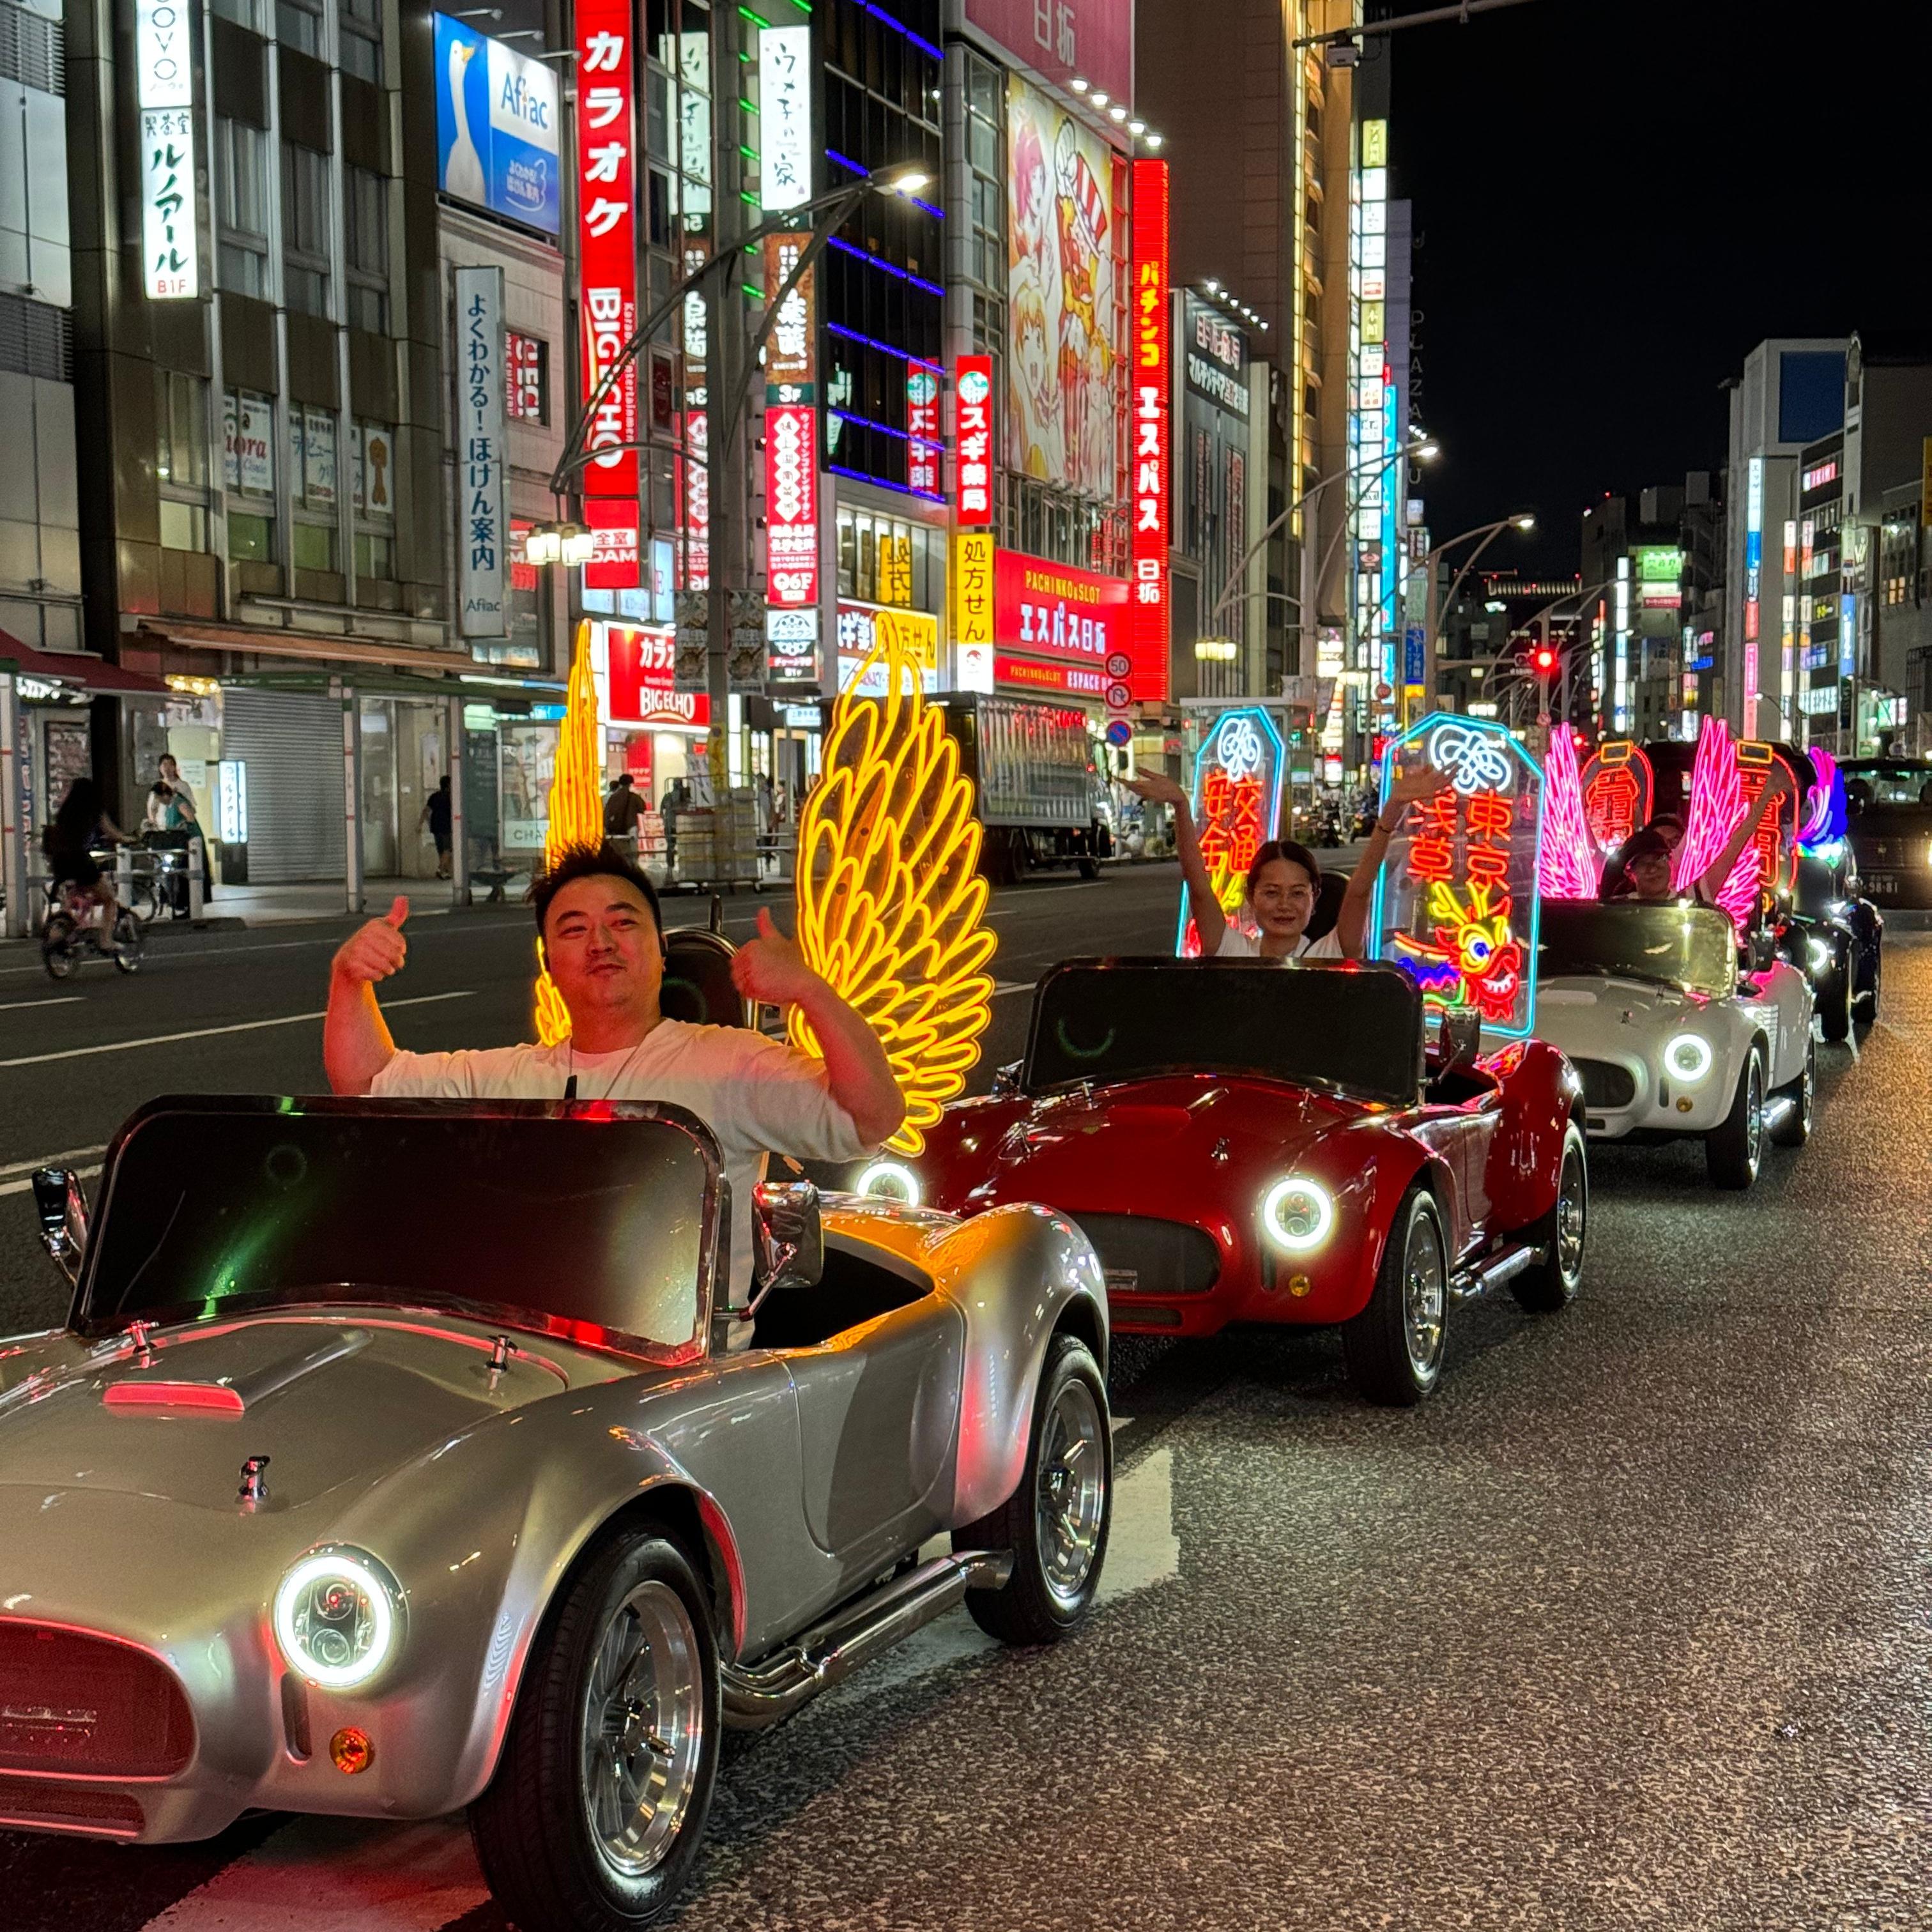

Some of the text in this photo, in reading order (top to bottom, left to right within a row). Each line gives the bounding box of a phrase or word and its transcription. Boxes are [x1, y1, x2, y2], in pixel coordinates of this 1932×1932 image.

[152, 0, 177, 80] OVO
[501, 71, 548, 130] Aflac
[583, 30, 629, 238] カラオケ
[150, 142, 190, 273] ルノアール
[587, 287, 622, 359] BIG
[960, 406, 988, 512] スギ薬局
[1137, 260, 1161, 604] パチンコ エスパス 日拓
[466, 598, 500, 613] Aflac
[964, 540, 986, 641] 処方せん
[1020, 601, 1106, 655] エスパス日拓
[1067, 671, 1100, 691] ESPACE
[1110, 660, 1127, 671] 50
[513, 829, 544, 841] CHA
[1465, 788, 1514, 892] 東京
